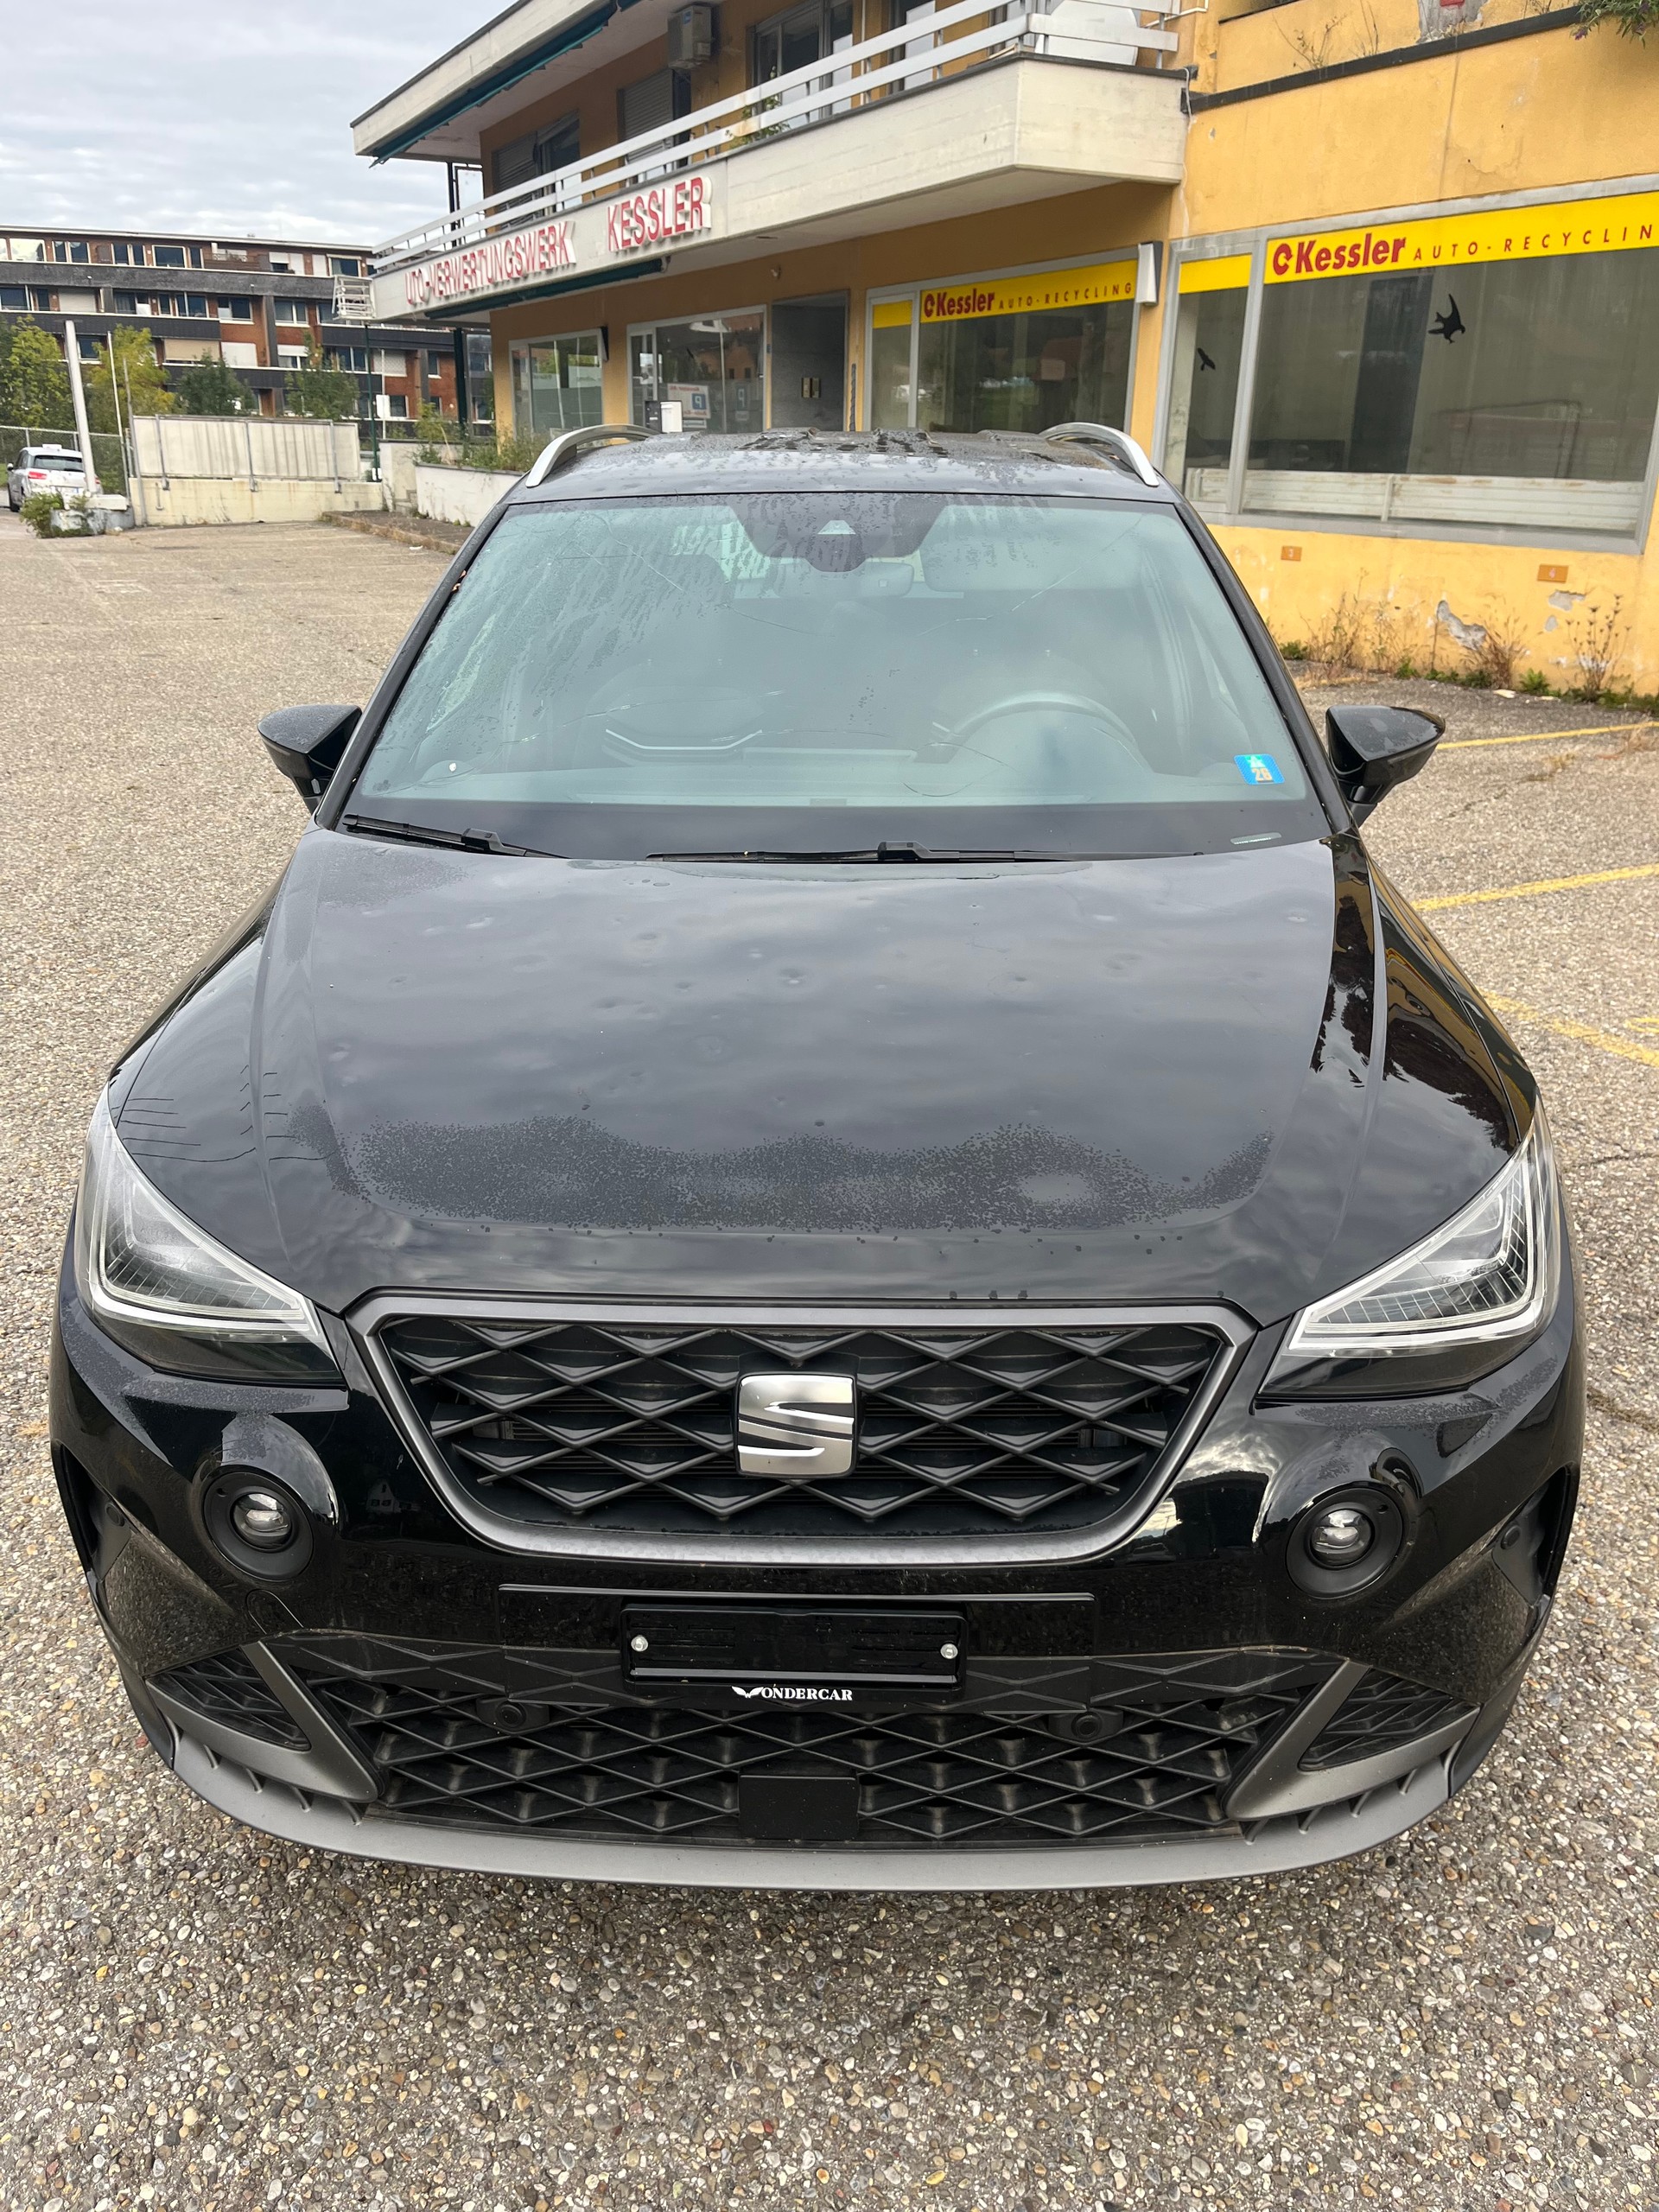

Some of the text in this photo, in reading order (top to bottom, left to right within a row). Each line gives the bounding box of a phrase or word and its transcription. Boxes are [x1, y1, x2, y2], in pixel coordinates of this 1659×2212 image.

[607, 176, 709, 251] KESSLER
[1294, 232, 1407, 274] Kessler
[936, 288, 995, 316] Kessler
